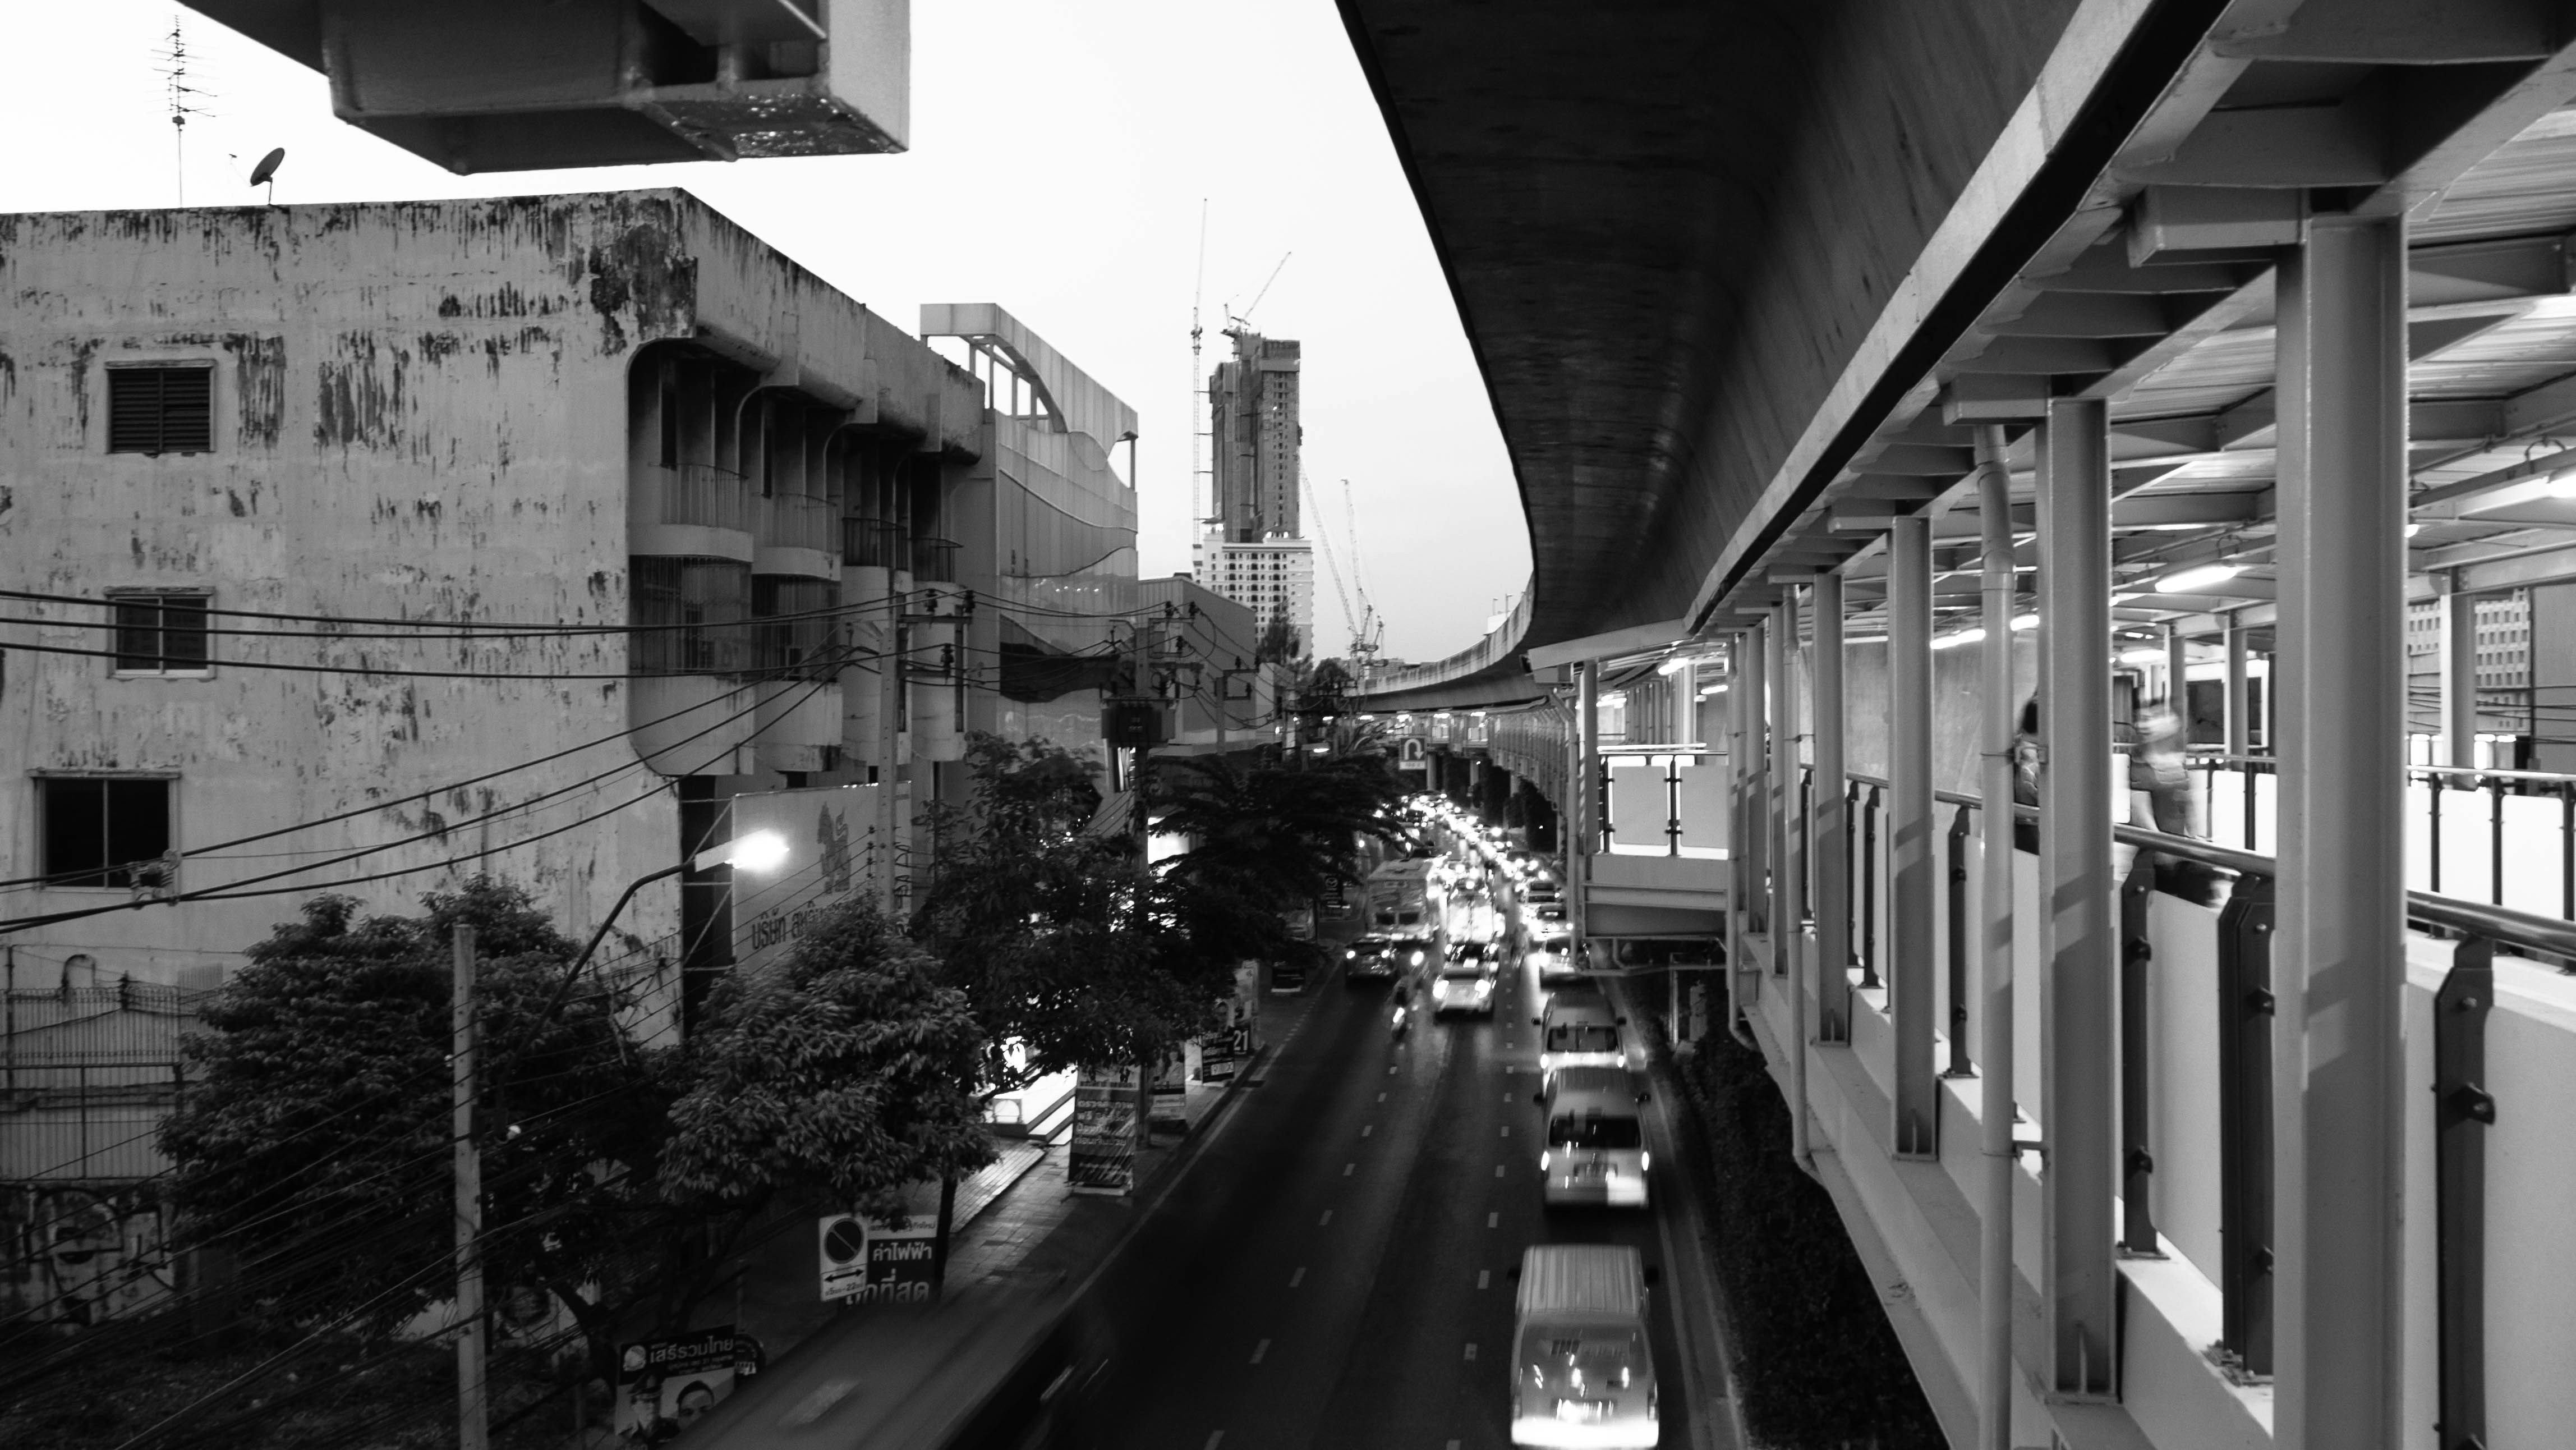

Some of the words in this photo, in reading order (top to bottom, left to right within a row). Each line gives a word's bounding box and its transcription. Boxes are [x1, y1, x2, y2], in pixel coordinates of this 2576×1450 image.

[752, 907, 786, 949] บริษัท
[872, 1241, 932, 1261] ค่าไฟฟ้า
[650, 1335, 734, 1364] เสรีรวมไทย
